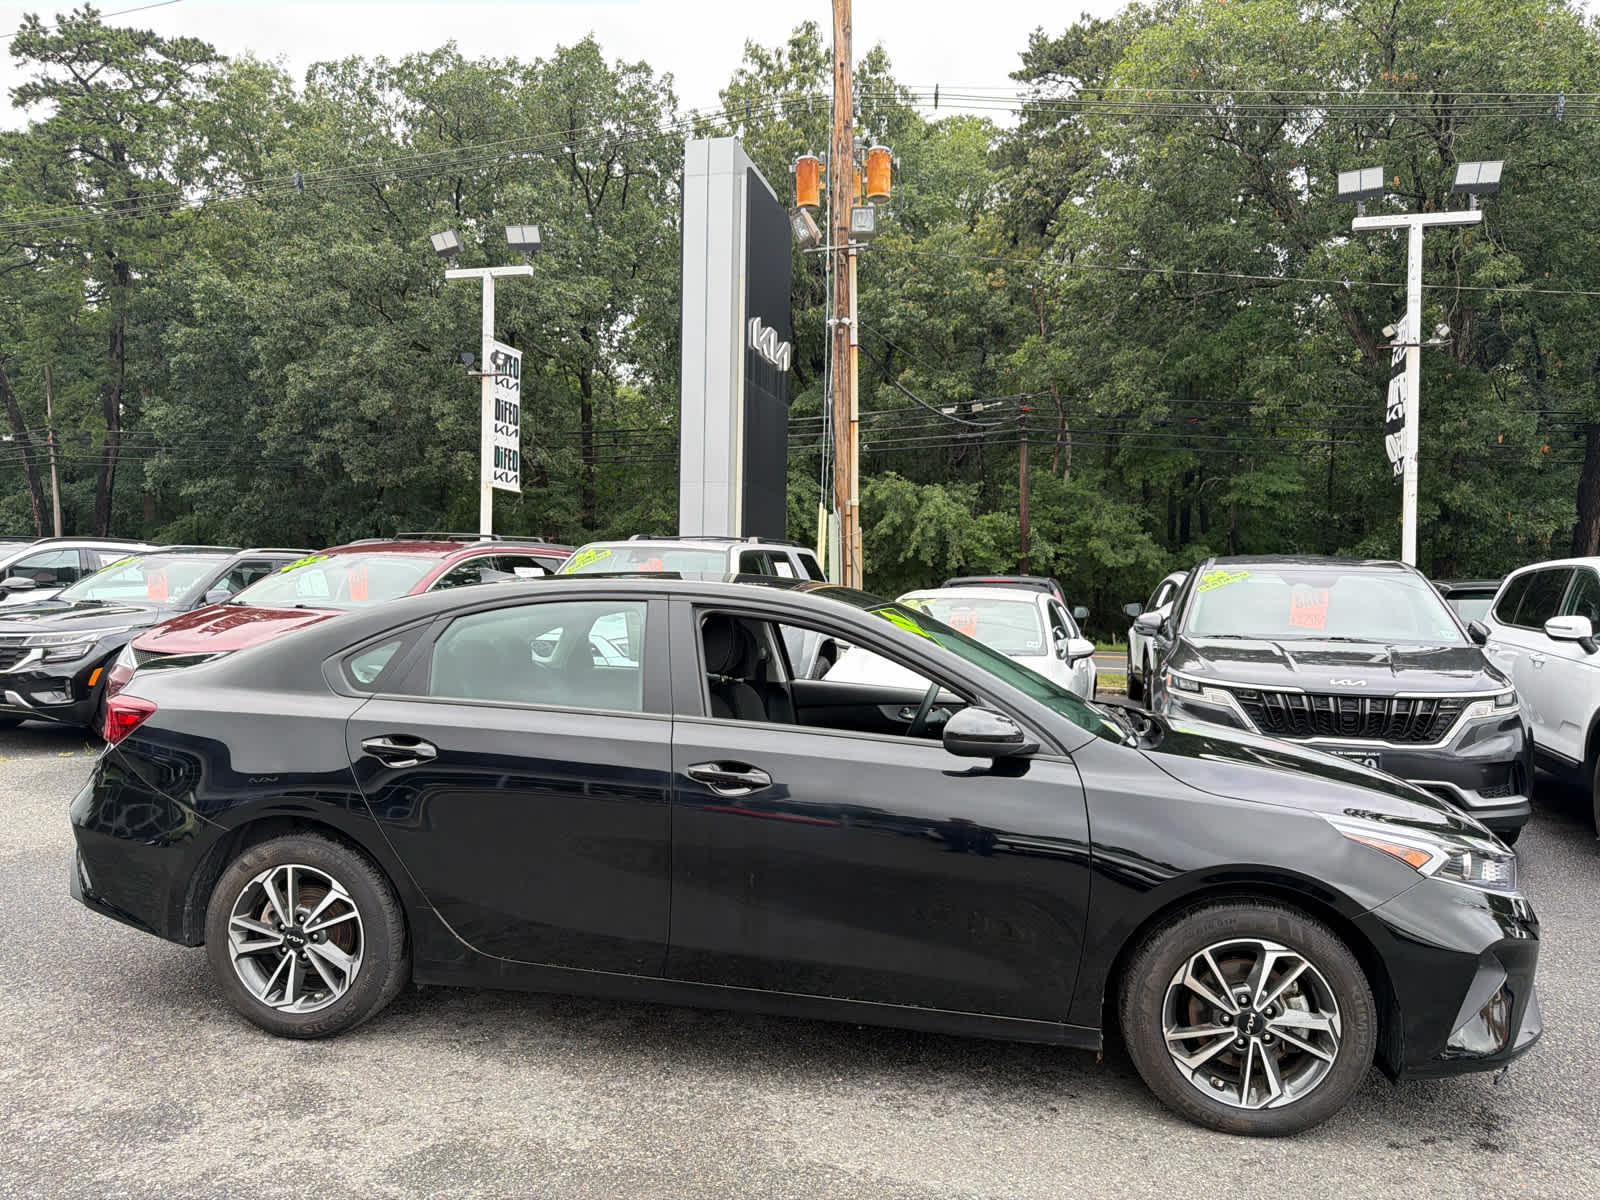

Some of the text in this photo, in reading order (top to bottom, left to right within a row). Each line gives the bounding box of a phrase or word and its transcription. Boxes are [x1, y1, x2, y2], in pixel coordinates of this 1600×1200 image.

[748, 316, 791, 371] KIA
[494, 423, 519, 438] KIA
[494, 470, 518, 484] KIA
